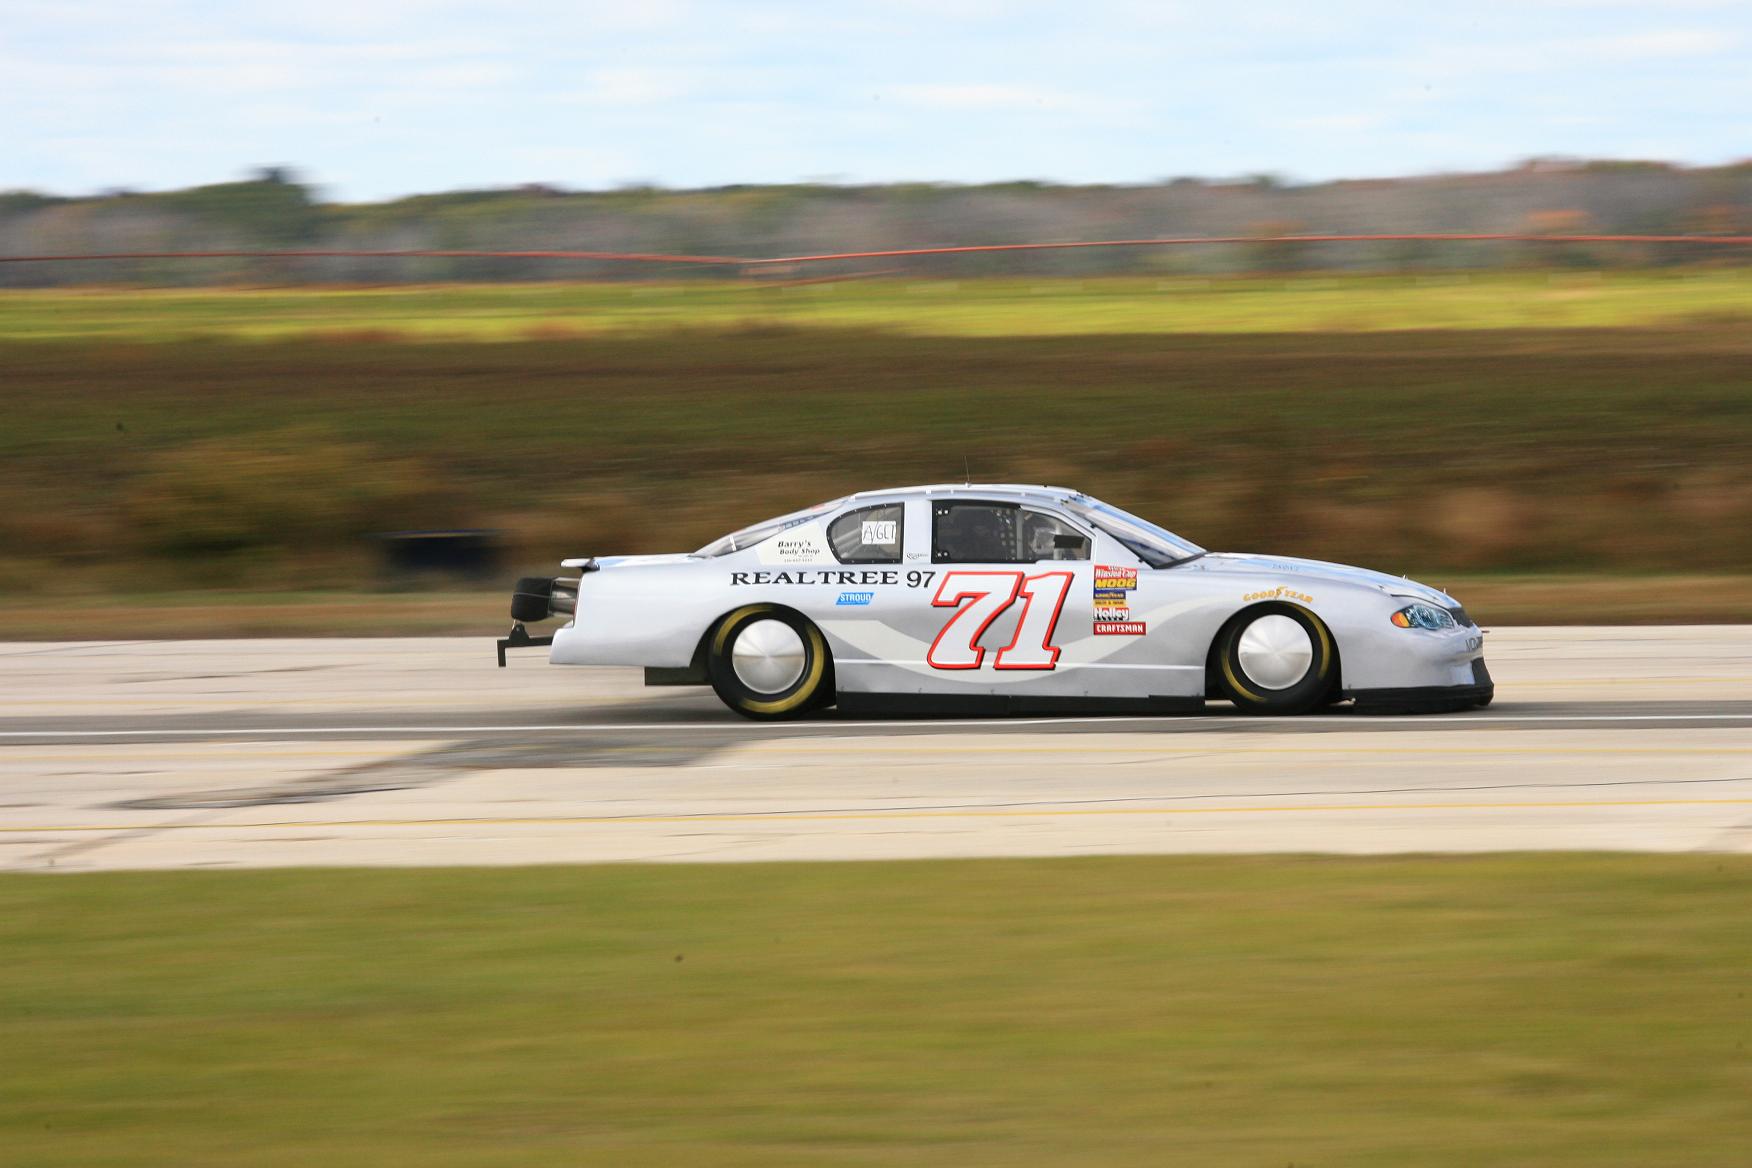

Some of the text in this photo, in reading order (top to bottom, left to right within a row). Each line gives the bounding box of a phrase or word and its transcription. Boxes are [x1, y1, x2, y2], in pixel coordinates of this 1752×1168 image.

[778, 540, 811, 549] Barry's
[780, 548, 799, 556] Body
[730, 570, 936, 588] REALTREE 97
[1095, 579, 1136, 588] MOOG
[840, 593, 872, 602] STROUD
[1094, 607, 1129, 620] Holley
[927, 571, 1075, 670] 71
[1096, 624, 1144, 632] CRAFTSMAN
